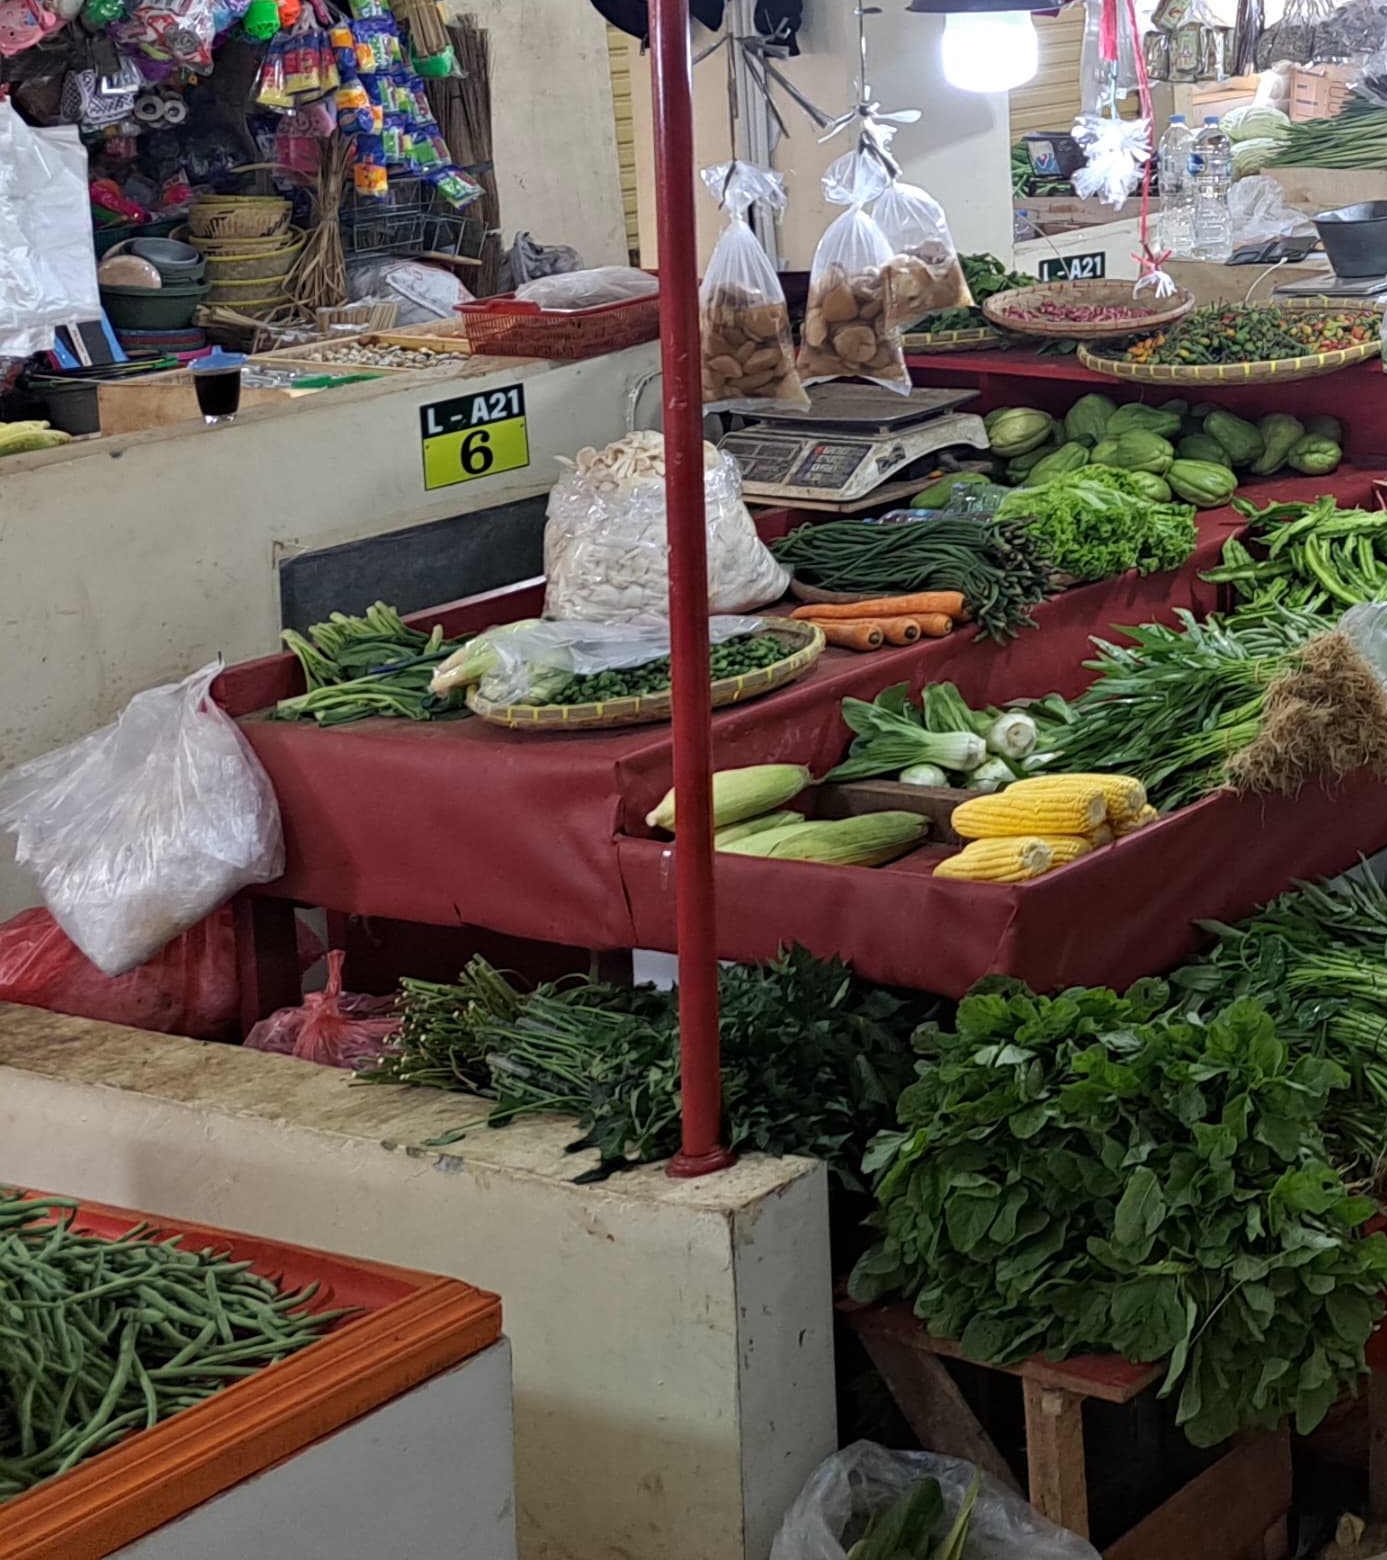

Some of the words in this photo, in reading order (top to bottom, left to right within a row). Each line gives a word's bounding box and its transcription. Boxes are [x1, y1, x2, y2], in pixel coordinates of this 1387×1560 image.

[1070, 255, 1102, 280] A21
[426, 407, 444, 435] L
[470, 388, 520, 425] A21
[461, 429, 493, 474] 6
